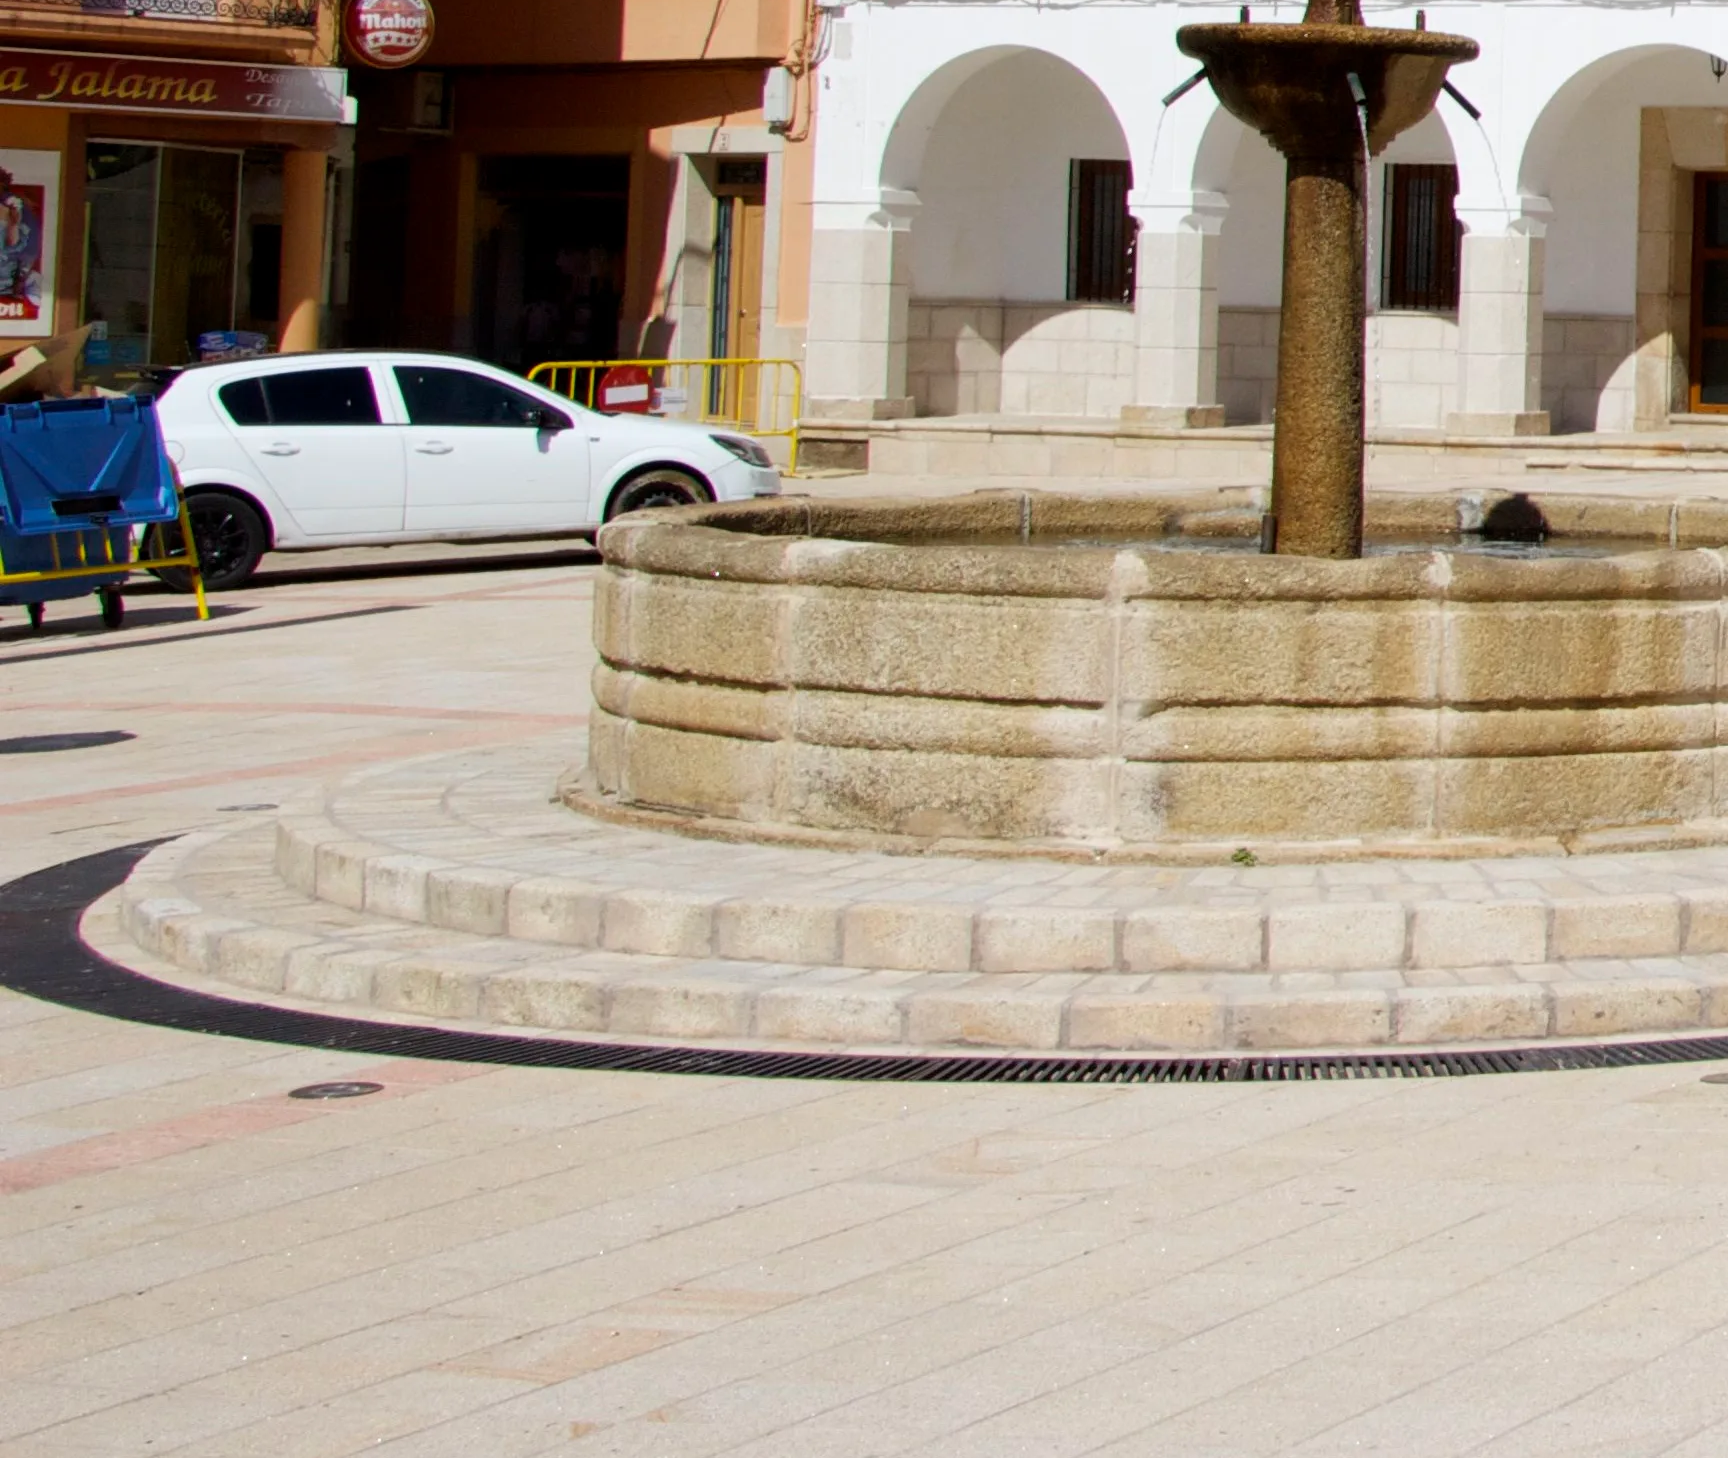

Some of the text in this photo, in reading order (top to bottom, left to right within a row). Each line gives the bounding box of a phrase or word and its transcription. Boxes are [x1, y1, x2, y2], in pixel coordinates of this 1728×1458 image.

[359, 13, 427, 29] Mahou
[0, 60, 217, 104] a Jalama
[0, 302, 24, 317] ou
